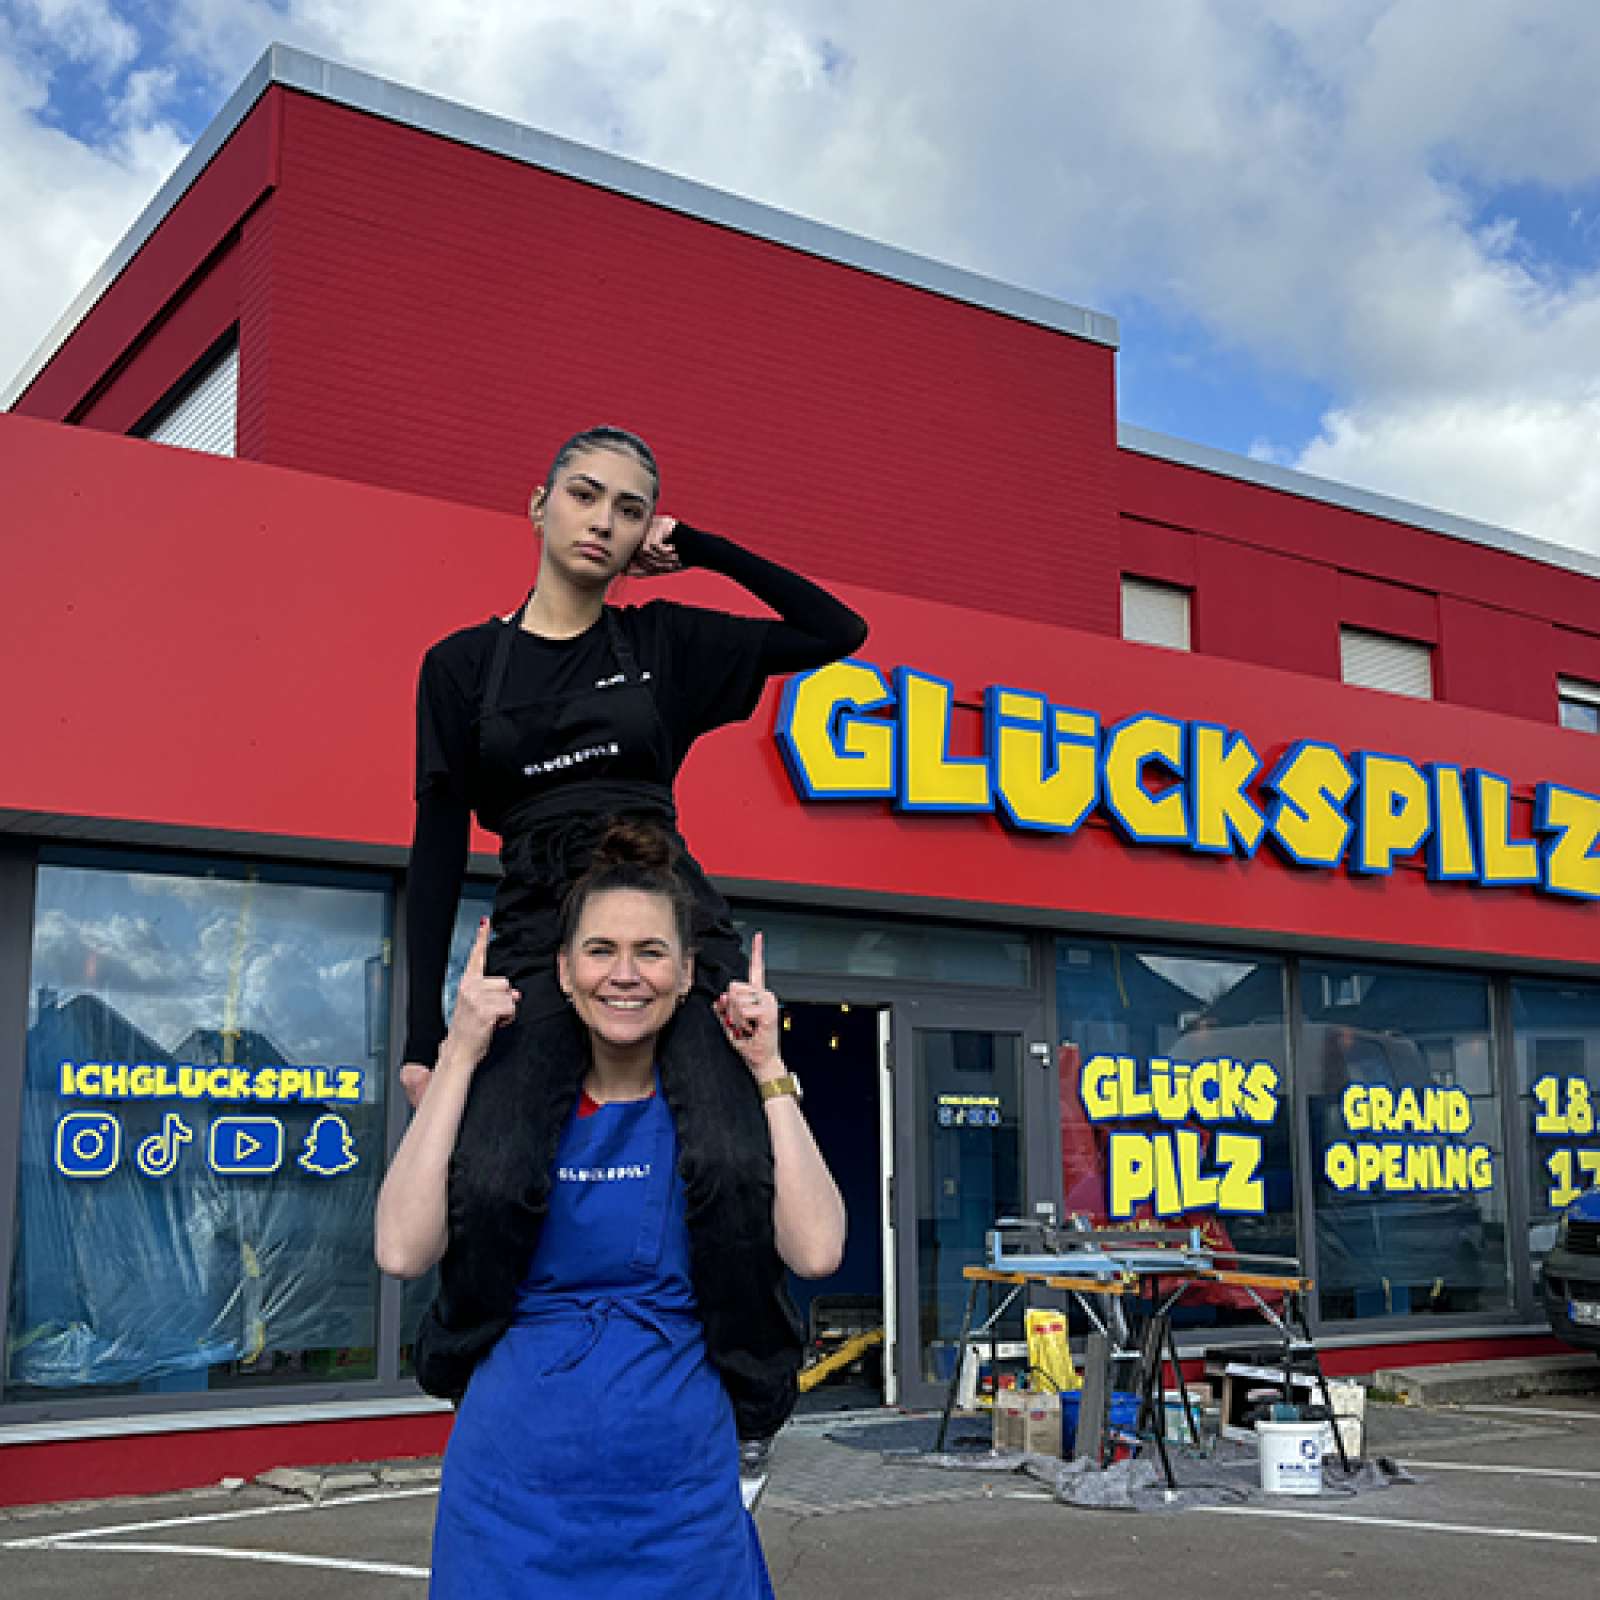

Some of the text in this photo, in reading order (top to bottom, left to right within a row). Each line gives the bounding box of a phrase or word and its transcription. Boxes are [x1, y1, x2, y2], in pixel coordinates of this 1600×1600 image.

[777, 658, 1600, 900] GLÜCKSPILZ
[60, 1060, 361, 1100] ICHGLUCKSPILZ
[1082, 1056, 1278, 1122] GLÜCKS
[1343, 1085, 1472, 1134] GRAND
[1533, 1075, 1600, 1135] 18
[1110, 1129, 1265, 1217] PILZ
[1325, 1144, 1492, 1192] OPENING
